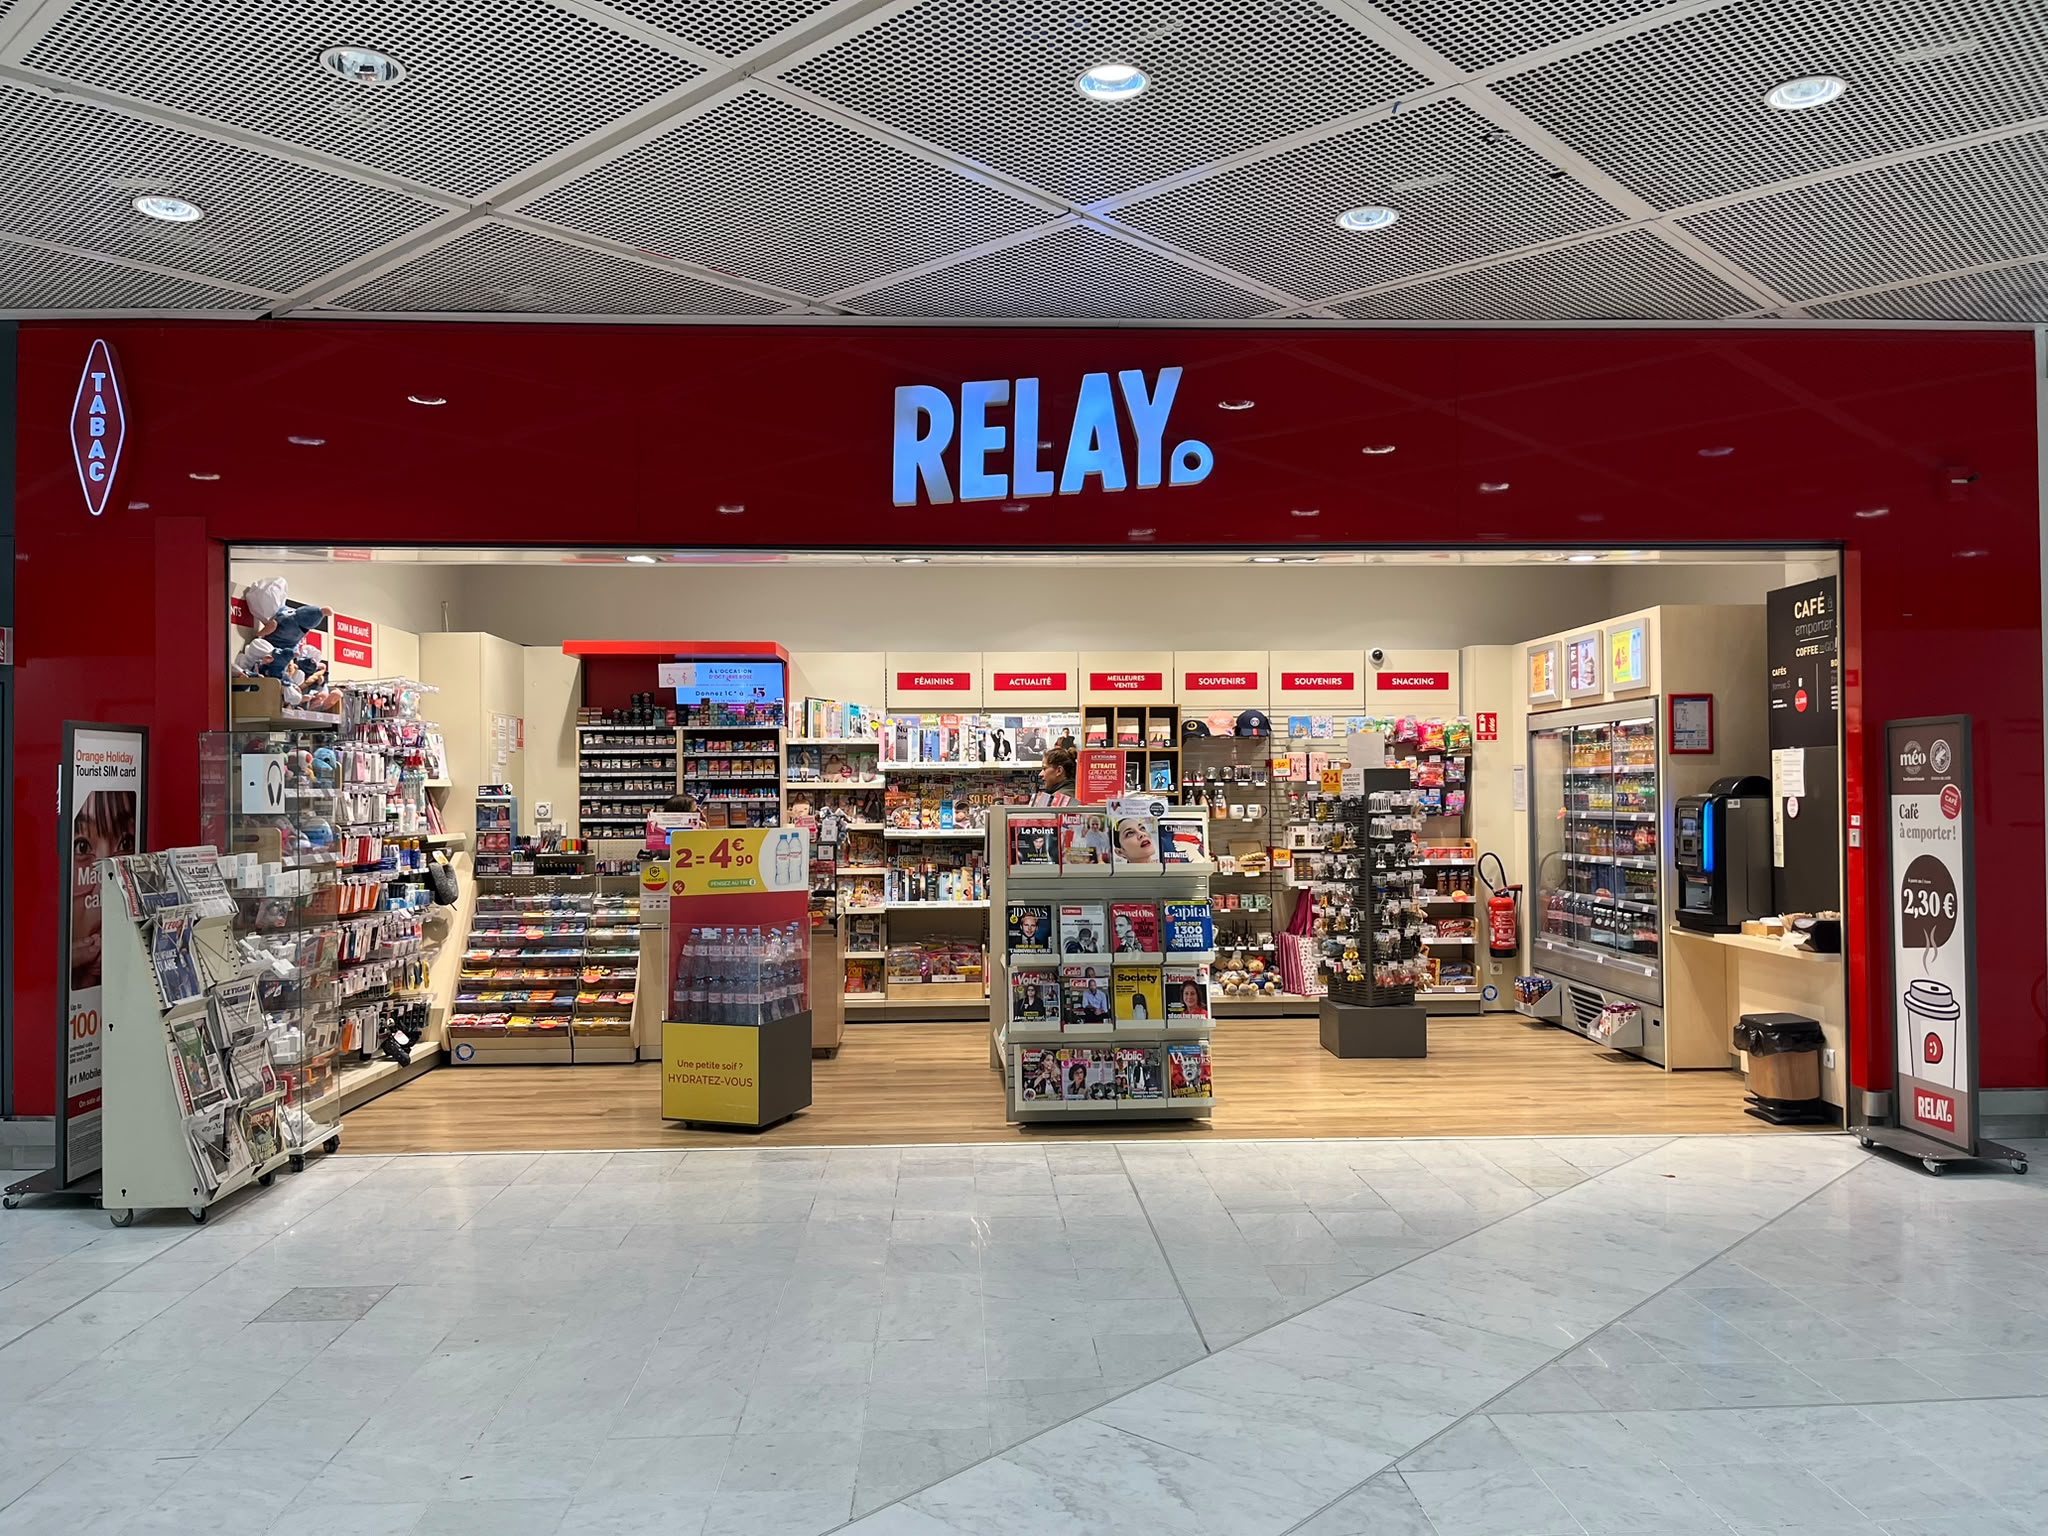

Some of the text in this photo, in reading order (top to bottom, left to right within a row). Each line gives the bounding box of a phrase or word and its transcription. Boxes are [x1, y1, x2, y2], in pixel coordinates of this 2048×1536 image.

[89, 372, 106, 482] TABAC
[893, 366, 1184, 507] RELAY
[1794, 591, 1825, 619] CAFÉ
[337, 621, 349, 632] SOIN
[353, 624, 369, 638] BEAUTÉ
[1795, 619, 1833, 636] emporter
[343, 647, 365, 660] CONFORT
[1796, 644, 1819, 657] COFFEE
[1772, 667, 1787, 677] CAFÉS
[914, 676, 954, 686] FÉMININS
[1009, 676, 1052, 686] ACTUALITÉ
[1198, 677, 1246, 685] SOUVENIRS
[1294, 677, 1342, 685] SOUVENIRS
[1391, 677, 1434, 686] SNACKING
[75, 749, 133, 765] Orange Holiday
[1900, 749, 1927, 766] méo
[75, 764, 136, 777] Tourist SIM card
[1323, 772, 1340, 783] 2+1
[1944, 794, 1958, 806] CAFÉ
[1899, 803, 1920, 820] Café
[1032, 827, 1055, 835] Point
[1899, 822, 1905, 839] à
[1903, 888, 1955, 919] 2,30 €
[1164, 904, 1210, 920] Capital
[1174, 926, 1203, 935] 1300
[1017, 972, 1040, 985] Voici
[1117, 973, 1158, 984] Society
[70, 1010, 98, 1040] 100
[1116, 1050, 1142, 1060] Public
[677, 1060, 694, 1069] Une
[695, 1061, 720, 1070] petite
[721, 1062, 737, 1070] soif
[70, 1068, 102, 1085] #1 Mobile
[668, 1073, 753, 1088] HYDRATEZ-VOUS
[1917, 1095, 1949, 1121] RELAY
